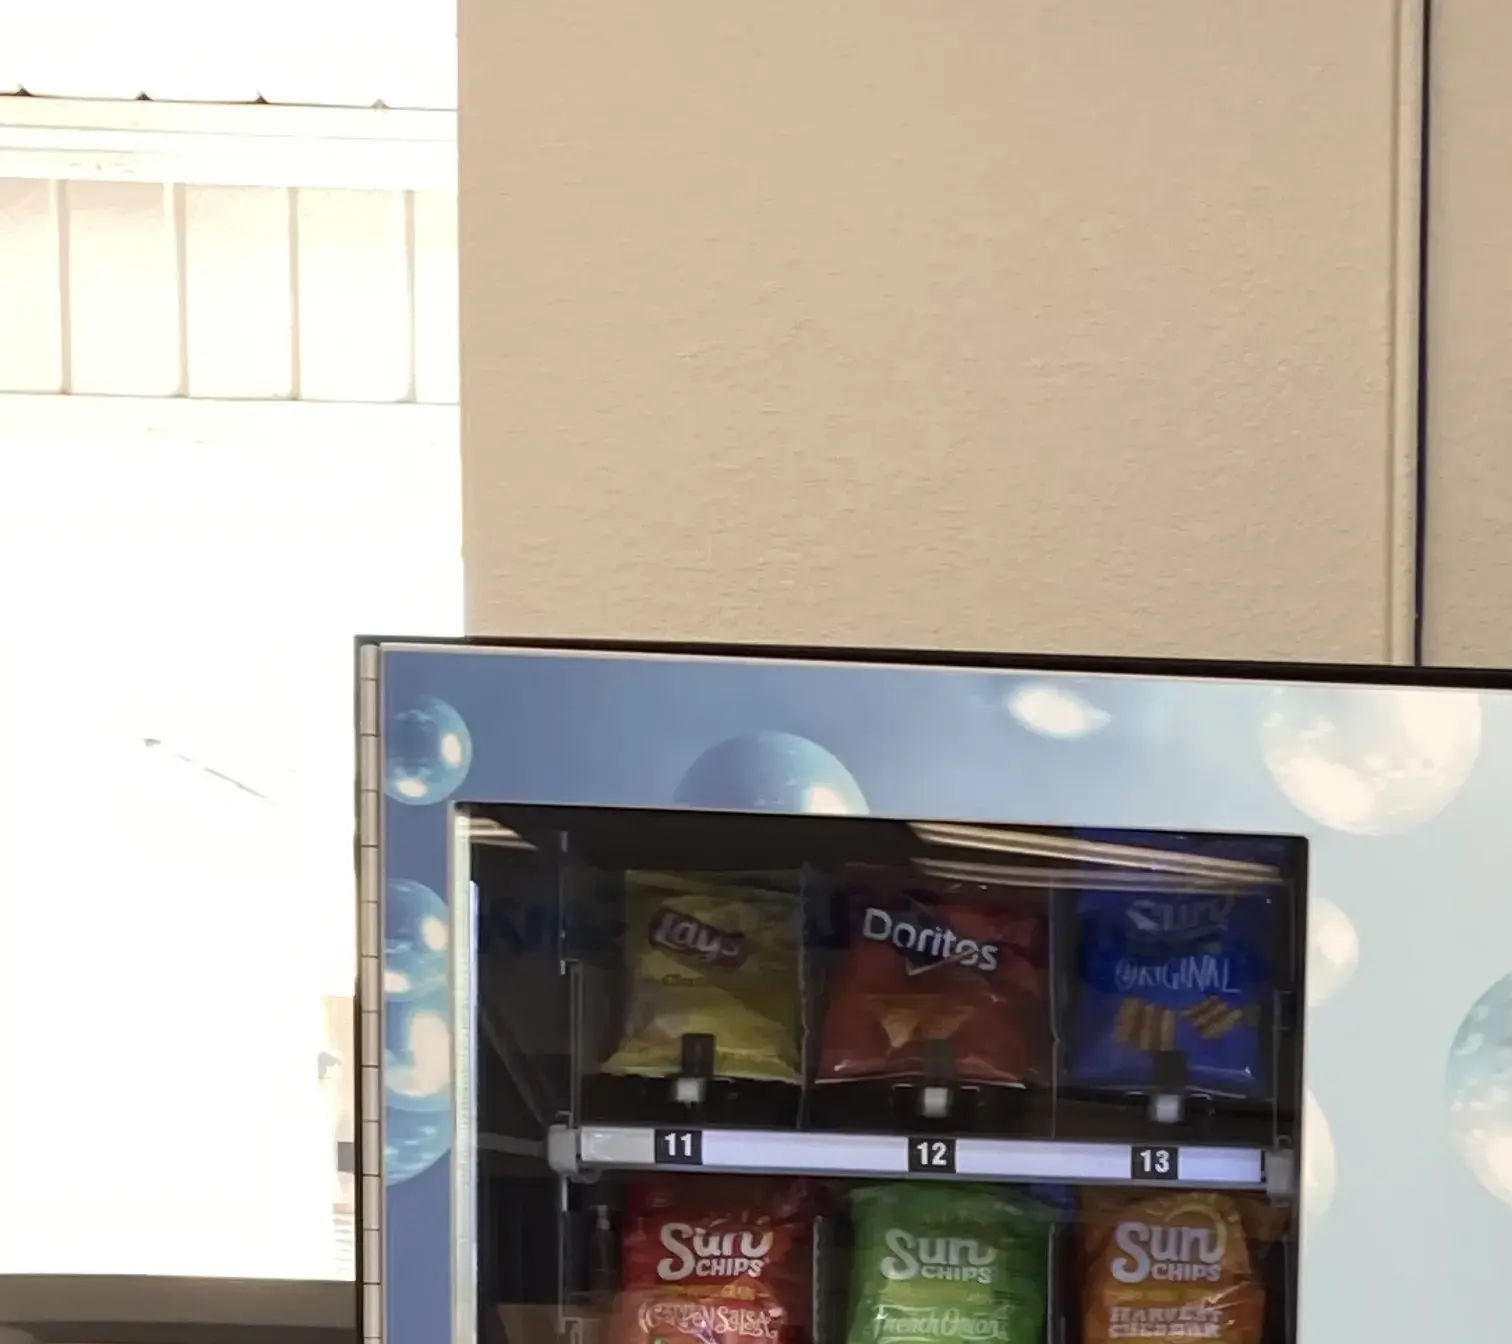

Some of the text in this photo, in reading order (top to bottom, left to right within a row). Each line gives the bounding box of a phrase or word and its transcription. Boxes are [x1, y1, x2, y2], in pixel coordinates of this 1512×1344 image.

[862, 907, 998, 971] Doritos
[664, 1134, 693, 1156] 11
[917, 1142, 948, 1166] 12
[1141, 1150, 1170, 1173] 13
[657, 1222, 773, 1281] Sun
[880, 1228, 998, 1280] Sun
[1111, 1221, 1225, 1284] Sun
[695, 1258, 764, 1278] CHIPS
[920, 1265, 992, 1284] CHIPS
[1151, 1263, 1222, 1282] CHIPS
